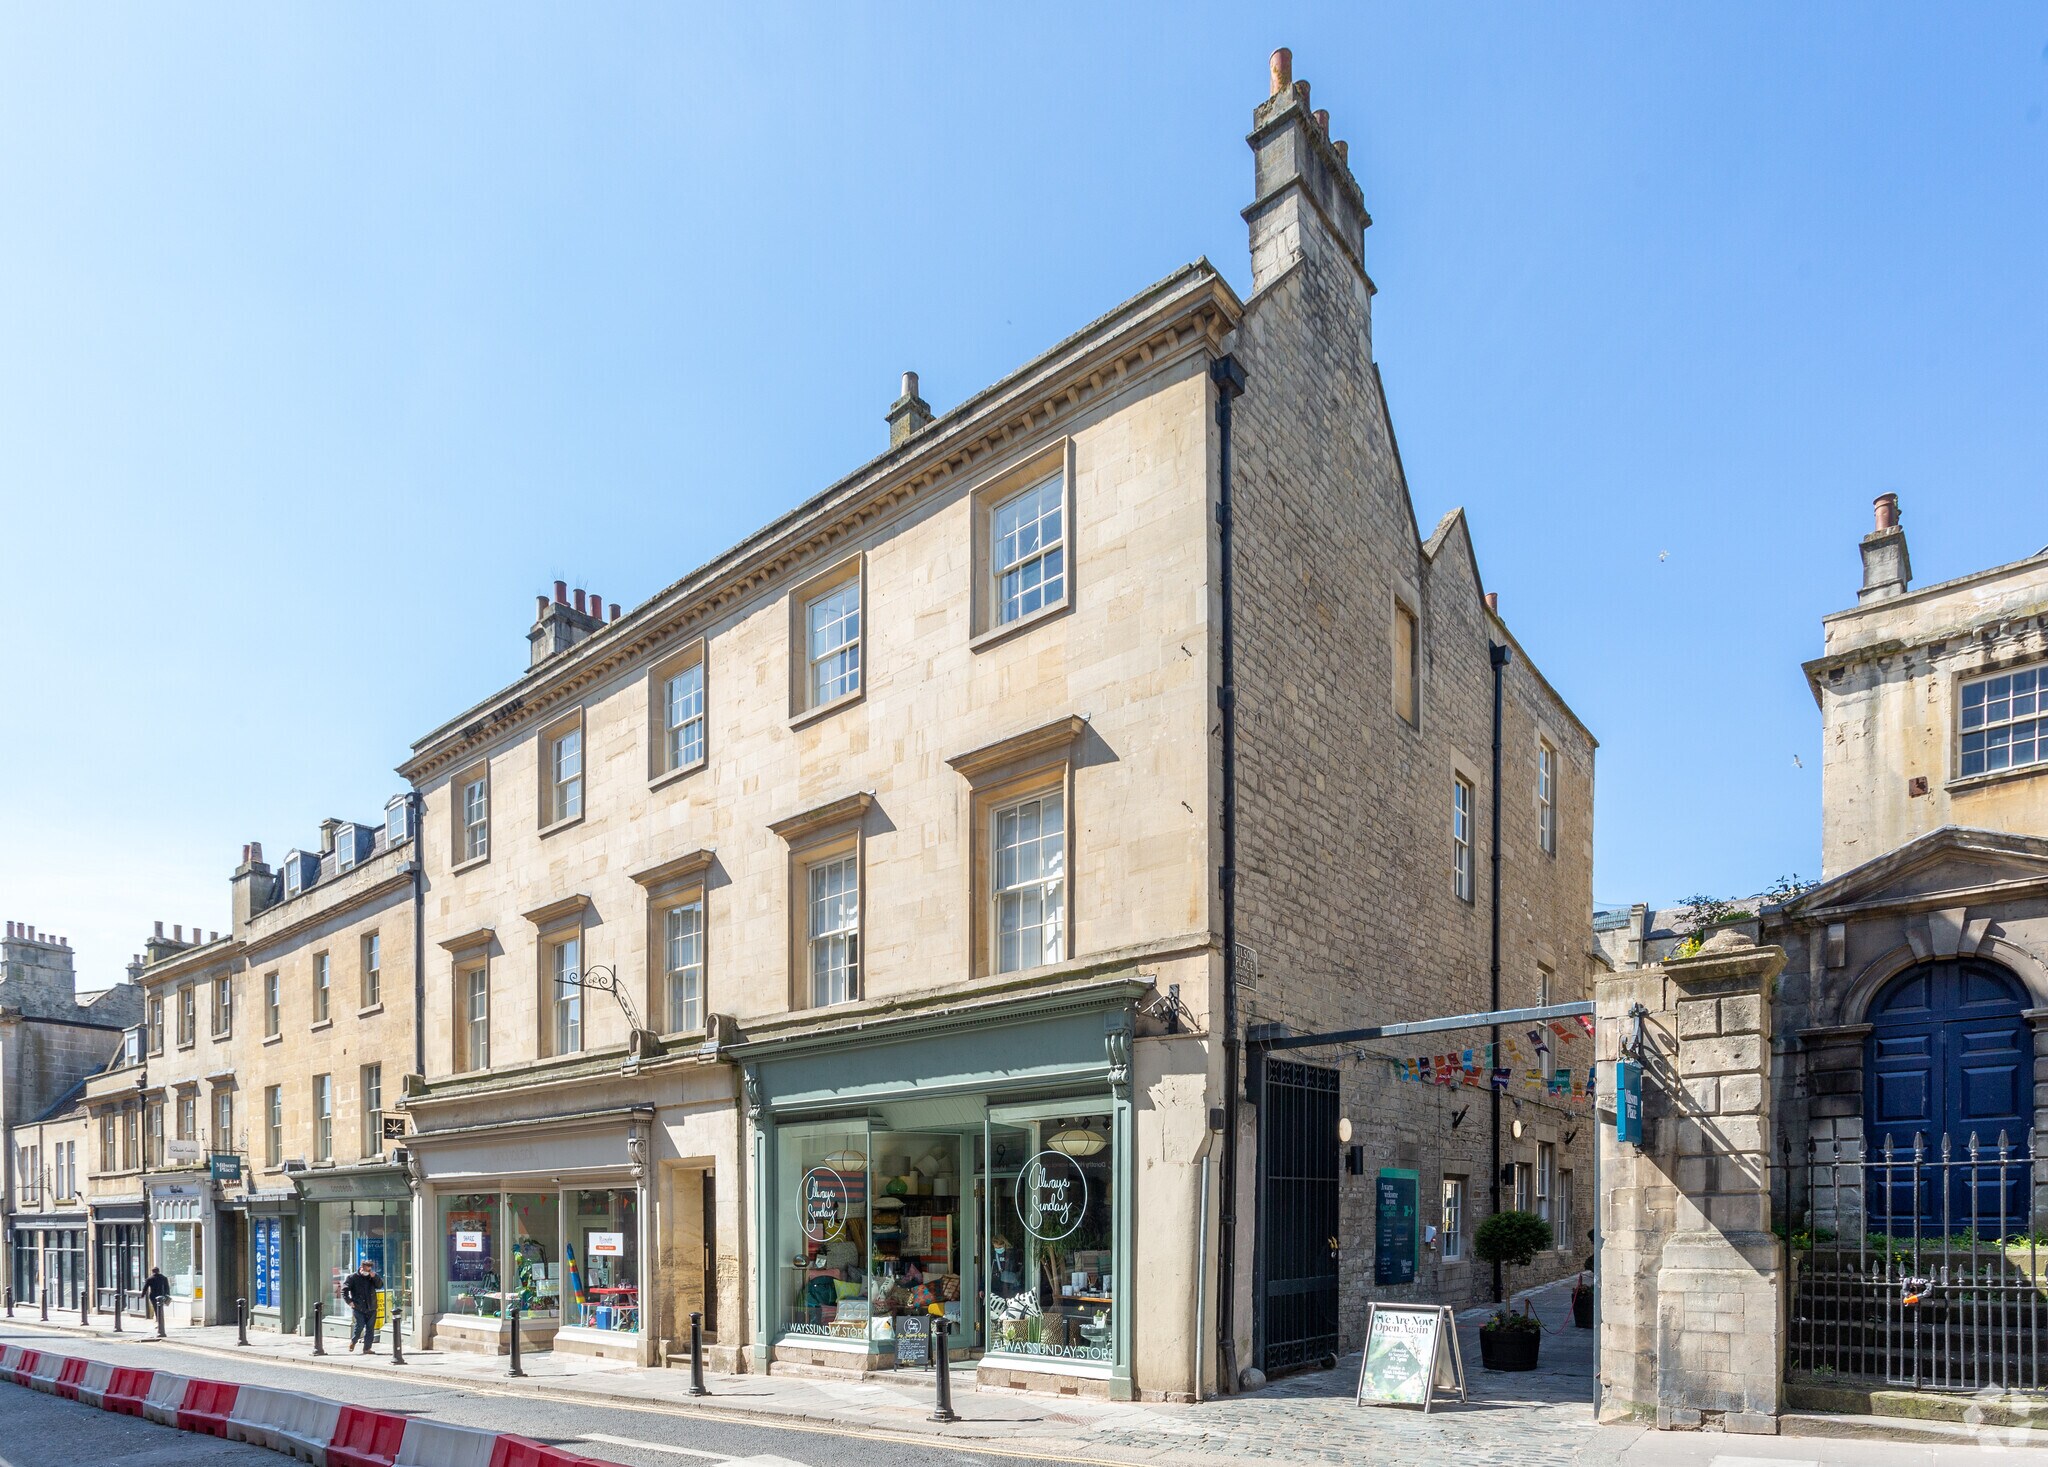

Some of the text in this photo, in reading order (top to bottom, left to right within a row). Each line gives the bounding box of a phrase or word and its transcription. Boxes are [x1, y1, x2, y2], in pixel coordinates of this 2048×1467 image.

[1624, 1089, 1638, 1106] Milsom
[1627, 1104, 1637, 1119] Place
[805, 1176, 836, 1208] Always
[1029, 1162, 1070, 1201] Always
[806, 1202, 837, 1233] Sunday
[1029, 1193, 1073, 1230] Sunday
[1375, 1323, 1428, 1334] Open Again
[1376, 1314, 1434, 1326] We Are Now
